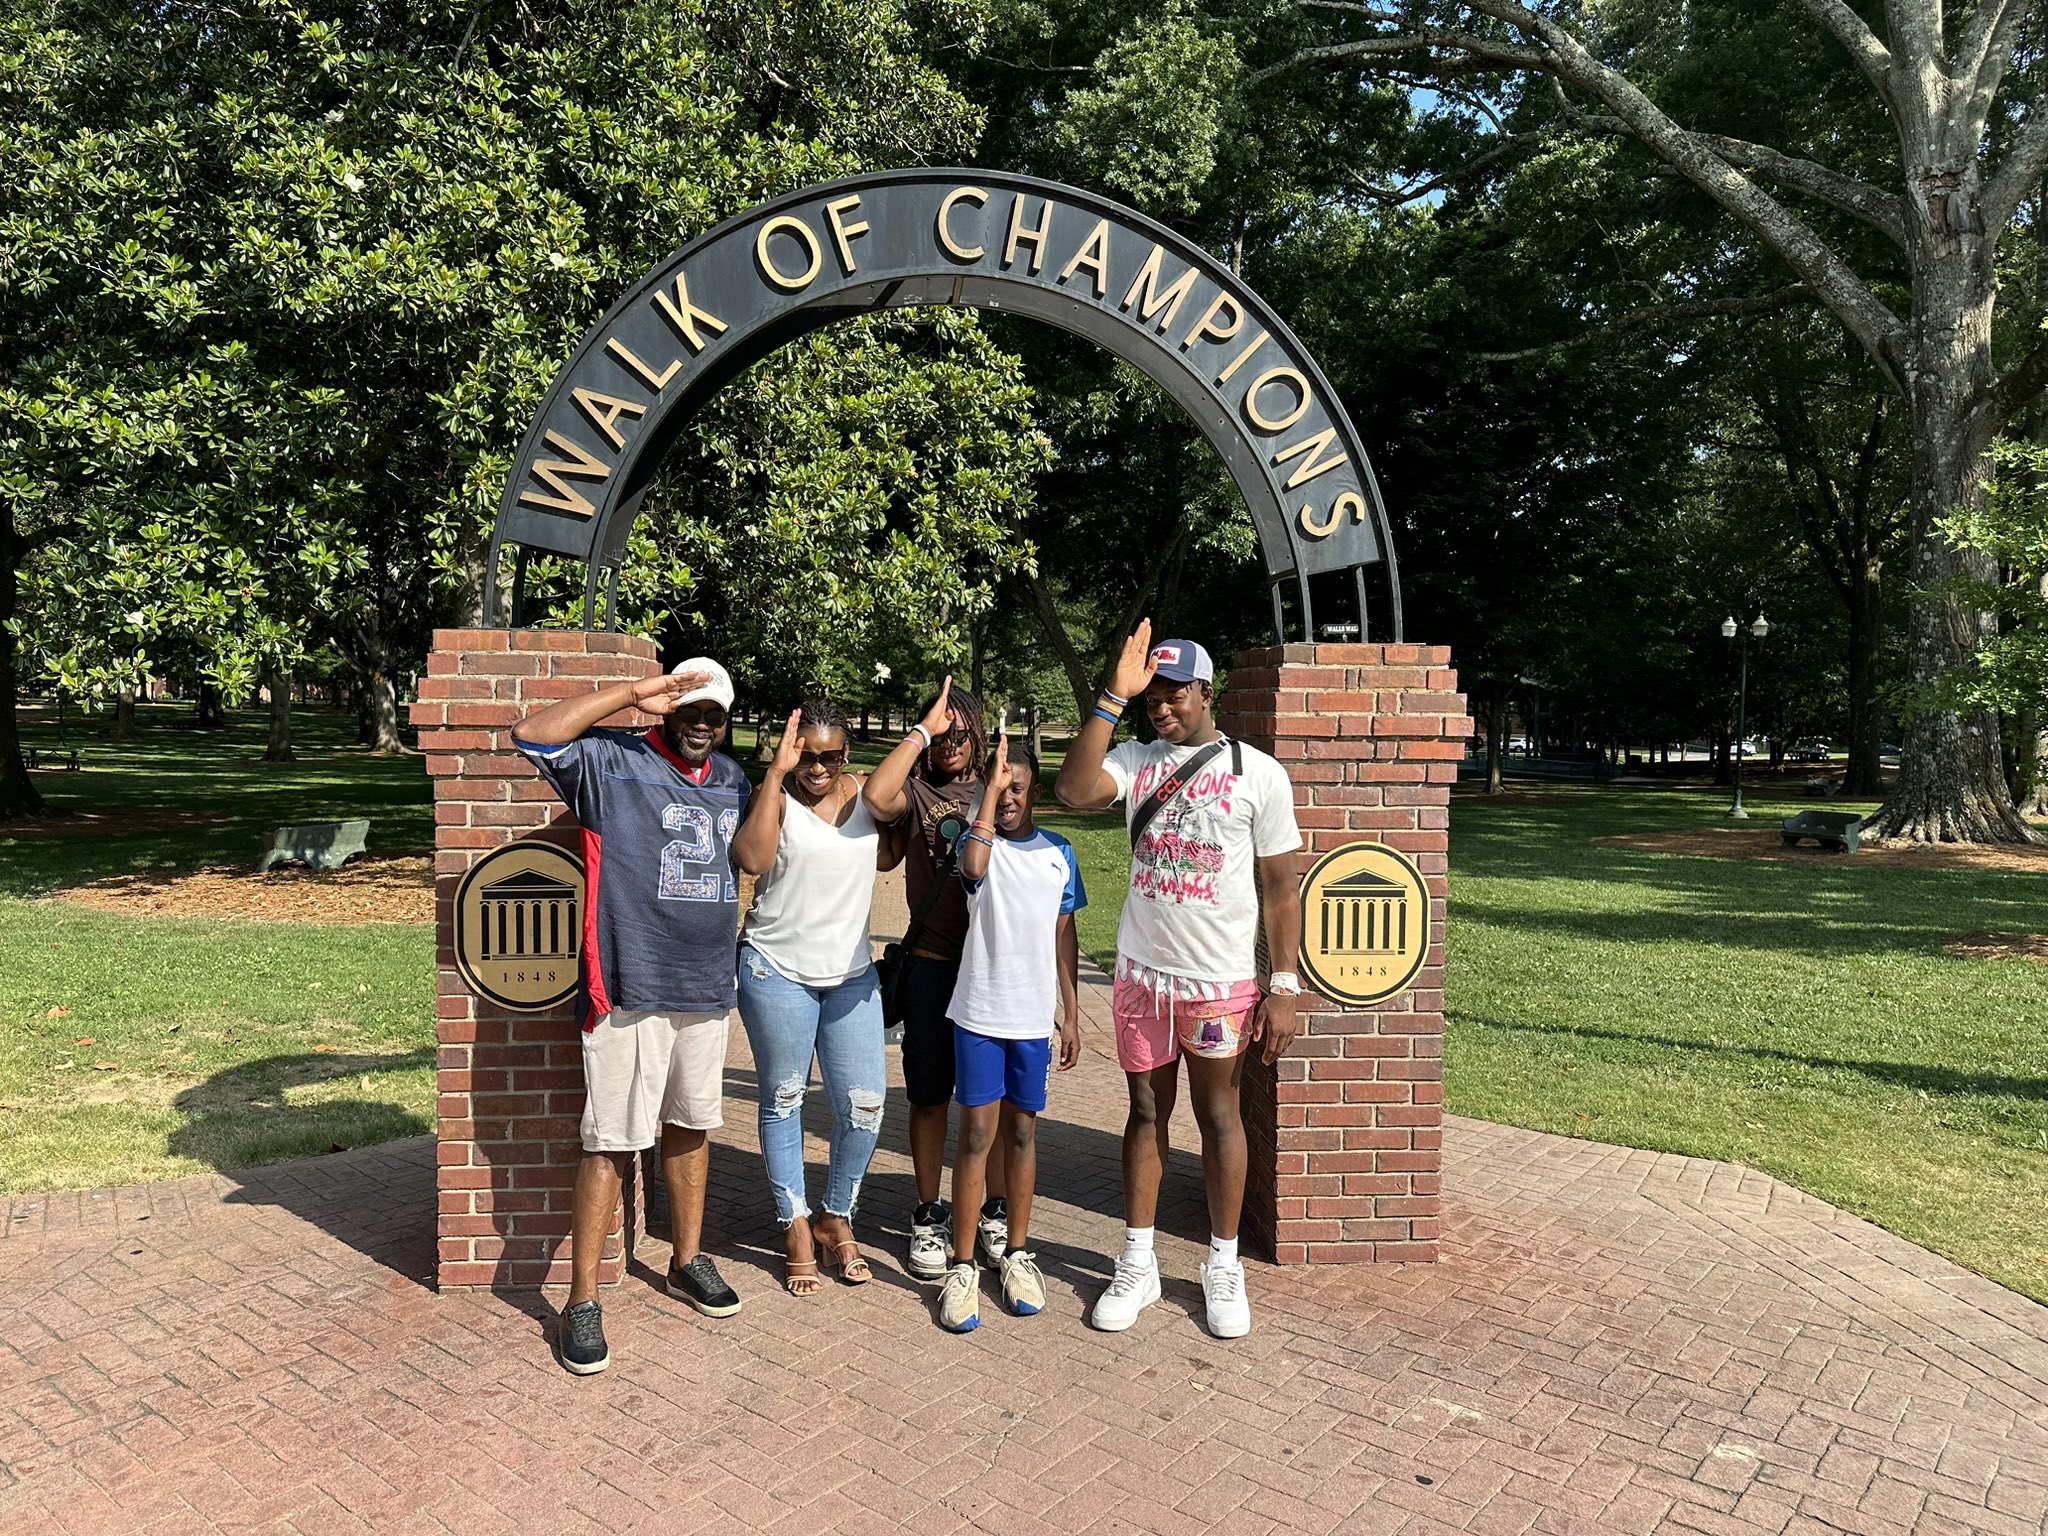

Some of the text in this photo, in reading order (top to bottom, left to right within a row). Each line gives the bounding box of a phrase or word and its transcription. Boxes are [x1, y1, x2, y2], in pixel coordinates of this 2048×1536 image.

[520, 186, 1365, 537] WALK OF CHAMPIONS
[1156, 777, 1183, 803] CCL
[1339, 966, 1387, 977] 1848
